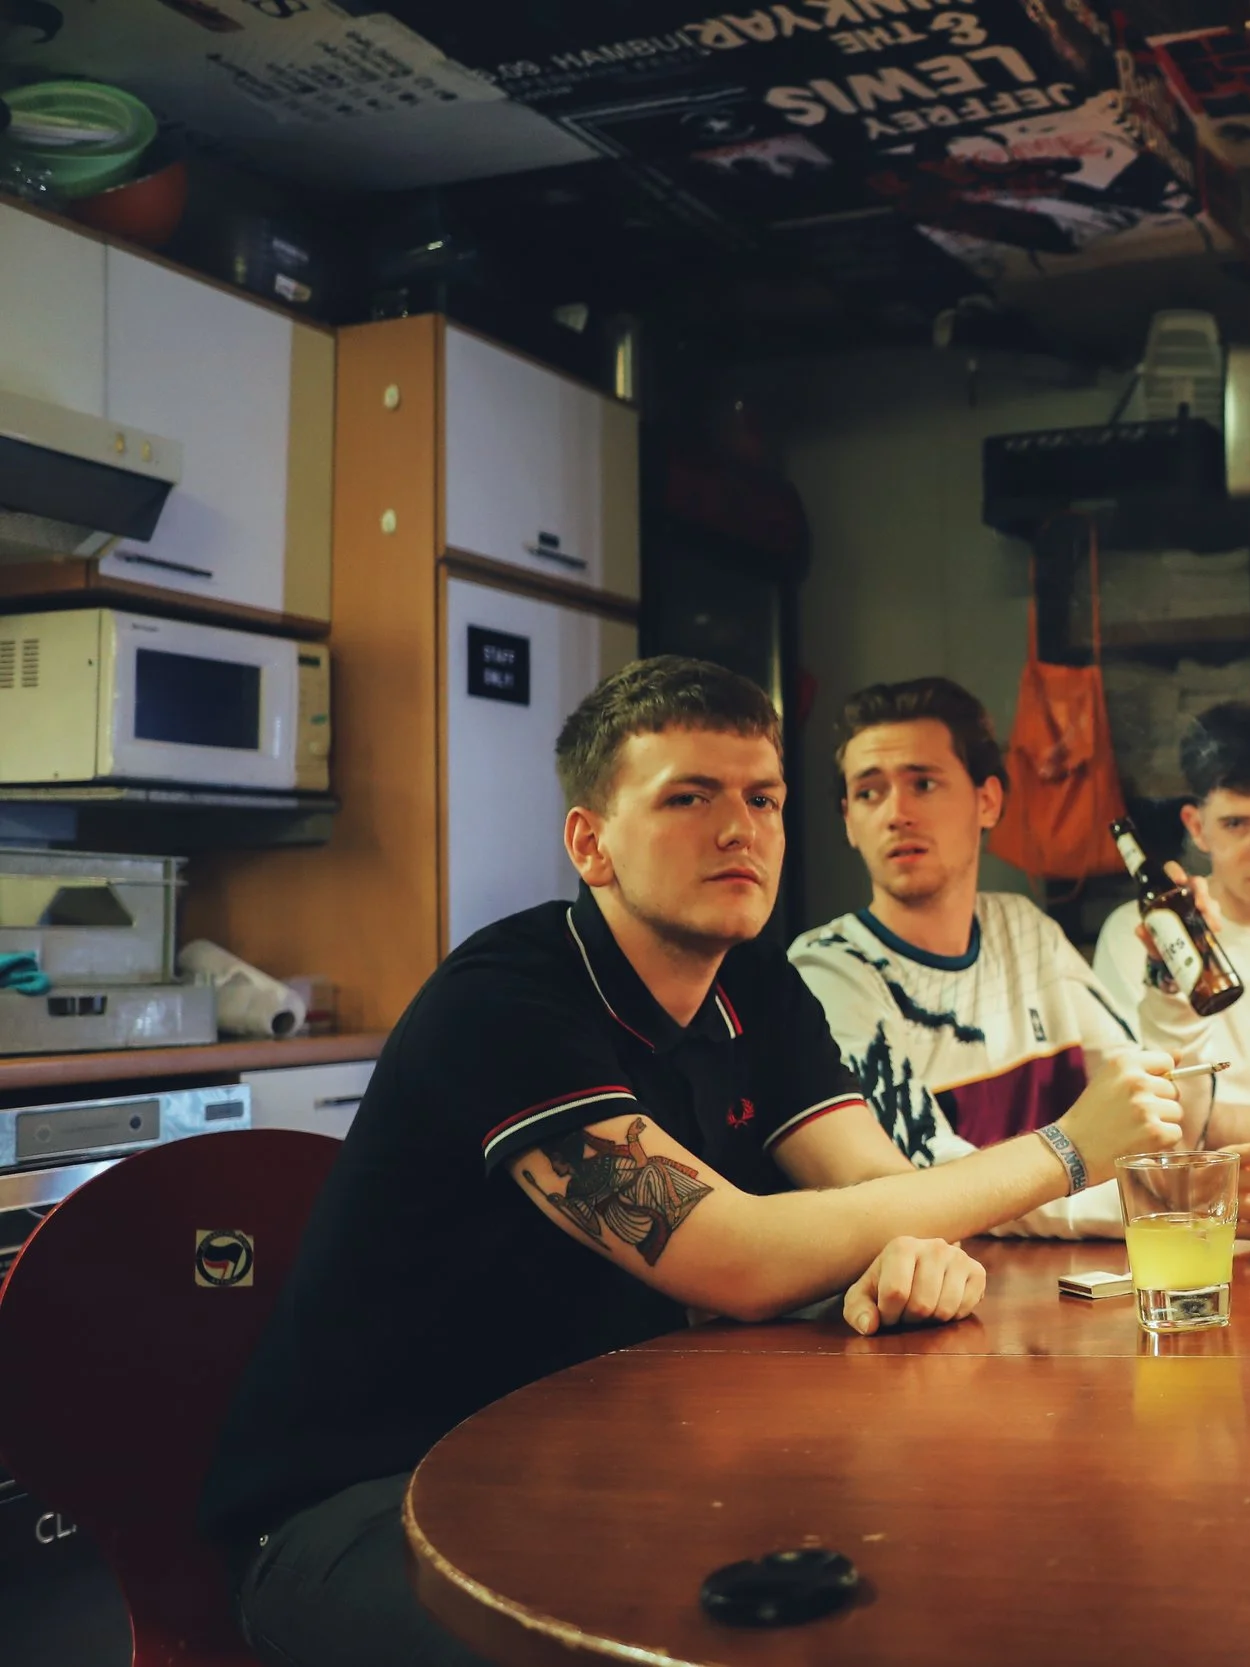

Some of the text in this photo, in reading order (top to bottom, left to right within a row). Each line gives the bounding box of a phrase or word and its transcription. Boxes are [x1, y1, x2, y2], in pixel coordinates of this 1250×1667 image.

[829, 12, 988, 54] & THE
[764, 45, 1037, 127] LEWIS
[863, 82, 1075, 140] JEFFREY
[1061, 1150, 1087, 1191] FRIDAY
[36, 1511, 77, 1544] CL
